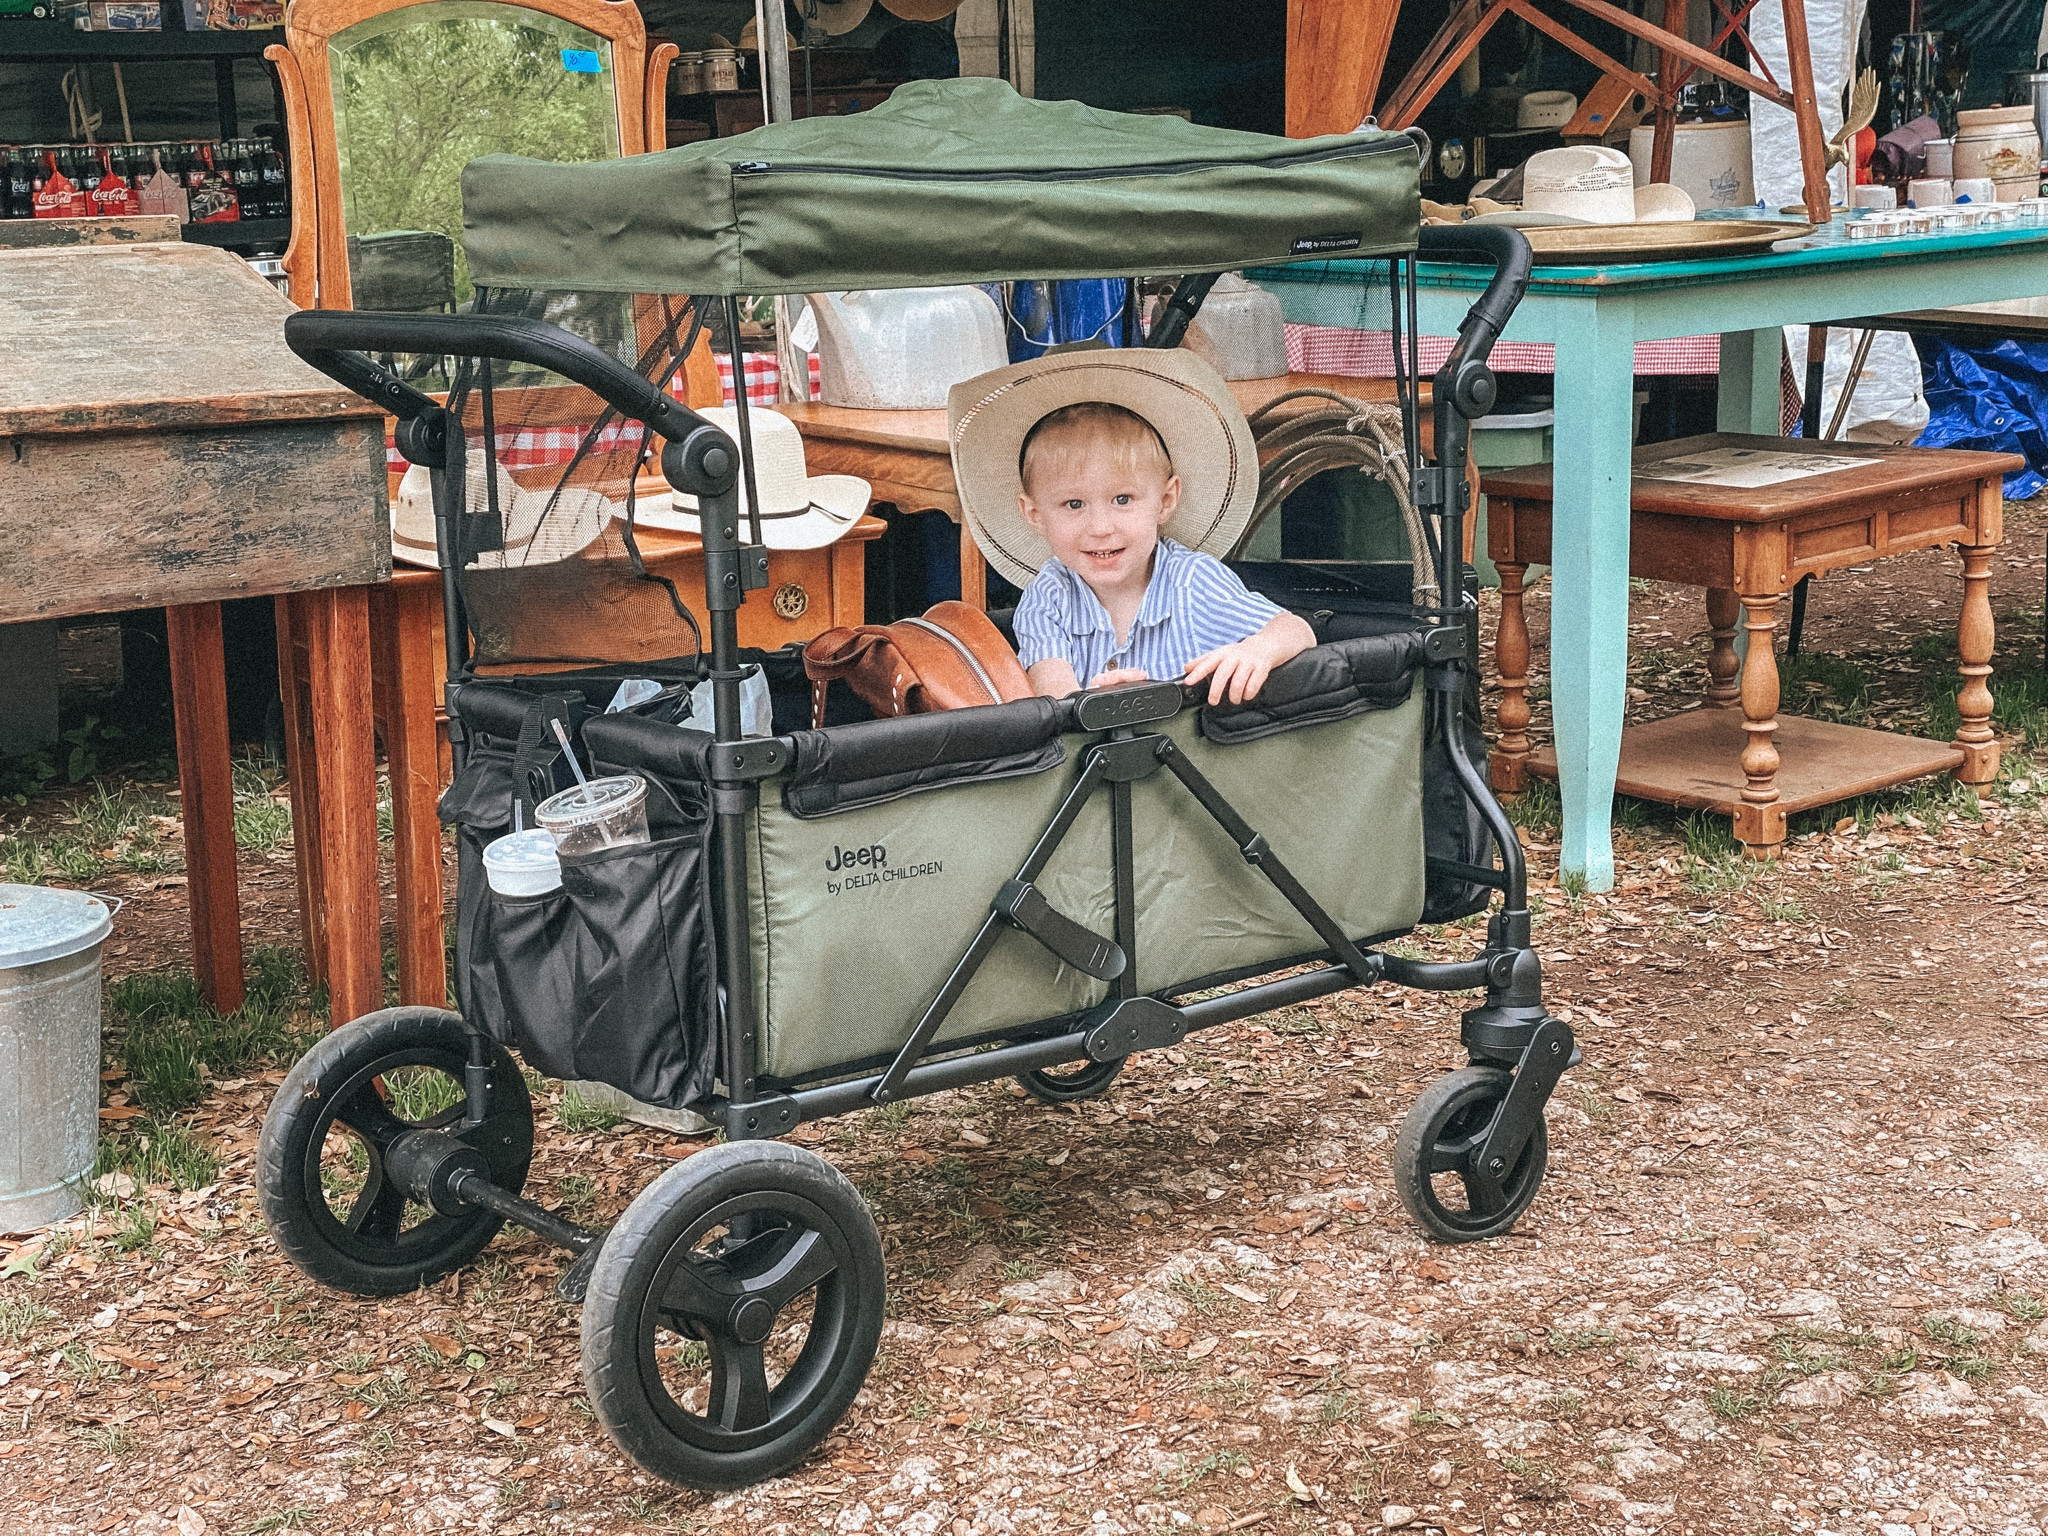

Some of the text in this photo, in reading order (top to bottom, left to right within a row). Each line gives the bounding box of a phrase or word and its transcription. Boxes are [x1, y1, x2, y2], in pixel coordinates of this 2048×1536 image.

[1296, 240, 1312, 249] Jeep
[825, 844, 887, 872] Jeep
[827, 860, 944, 896] by DELTA CHILDREN
